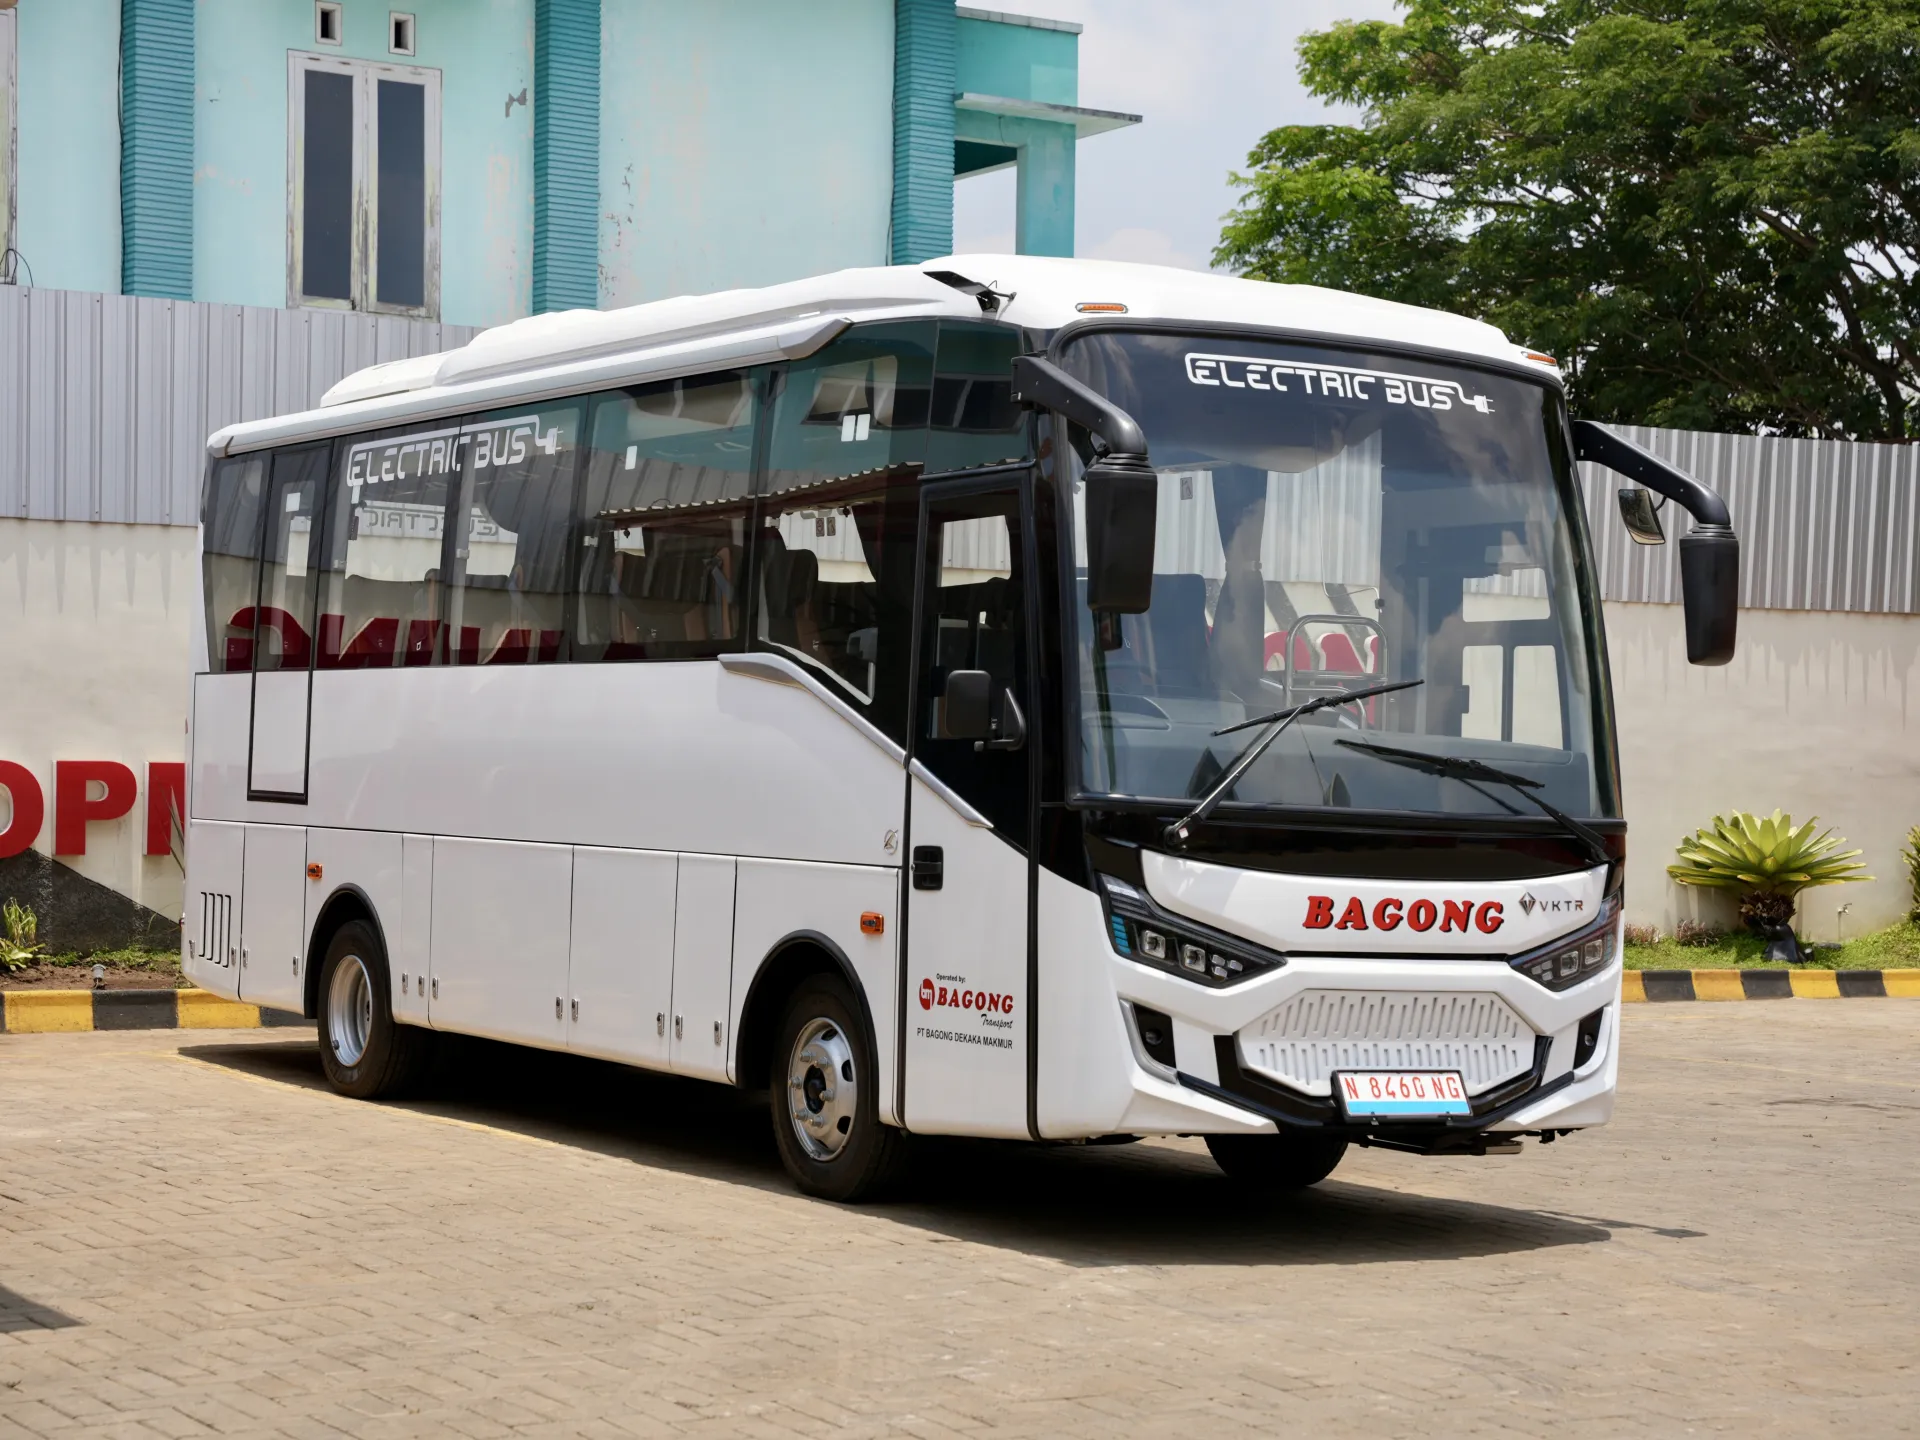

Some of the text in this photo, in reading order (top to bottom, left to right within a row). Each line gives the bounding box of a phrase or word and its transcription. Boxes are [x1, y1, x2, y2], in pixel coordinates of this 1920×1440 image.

[1188, 356, 1455, 411] ELECTRIC BUS
[348, 426, 532, 486] ELECTRIC BUS
[1302, 895, 1504, 934] BAGONG
[1540, 899, 1585, 913] VKTR
[936, 973, 957, 982] Operated
[937, 987, 1014, 1014] BAGONG
[981, 1013, 1013, 1030] Transport
[917, 1027, 1013, 1050] PT BAGONG DEKAKA MAKMUR
[1344, 1076, 1460, 1099] N 8460 NG
